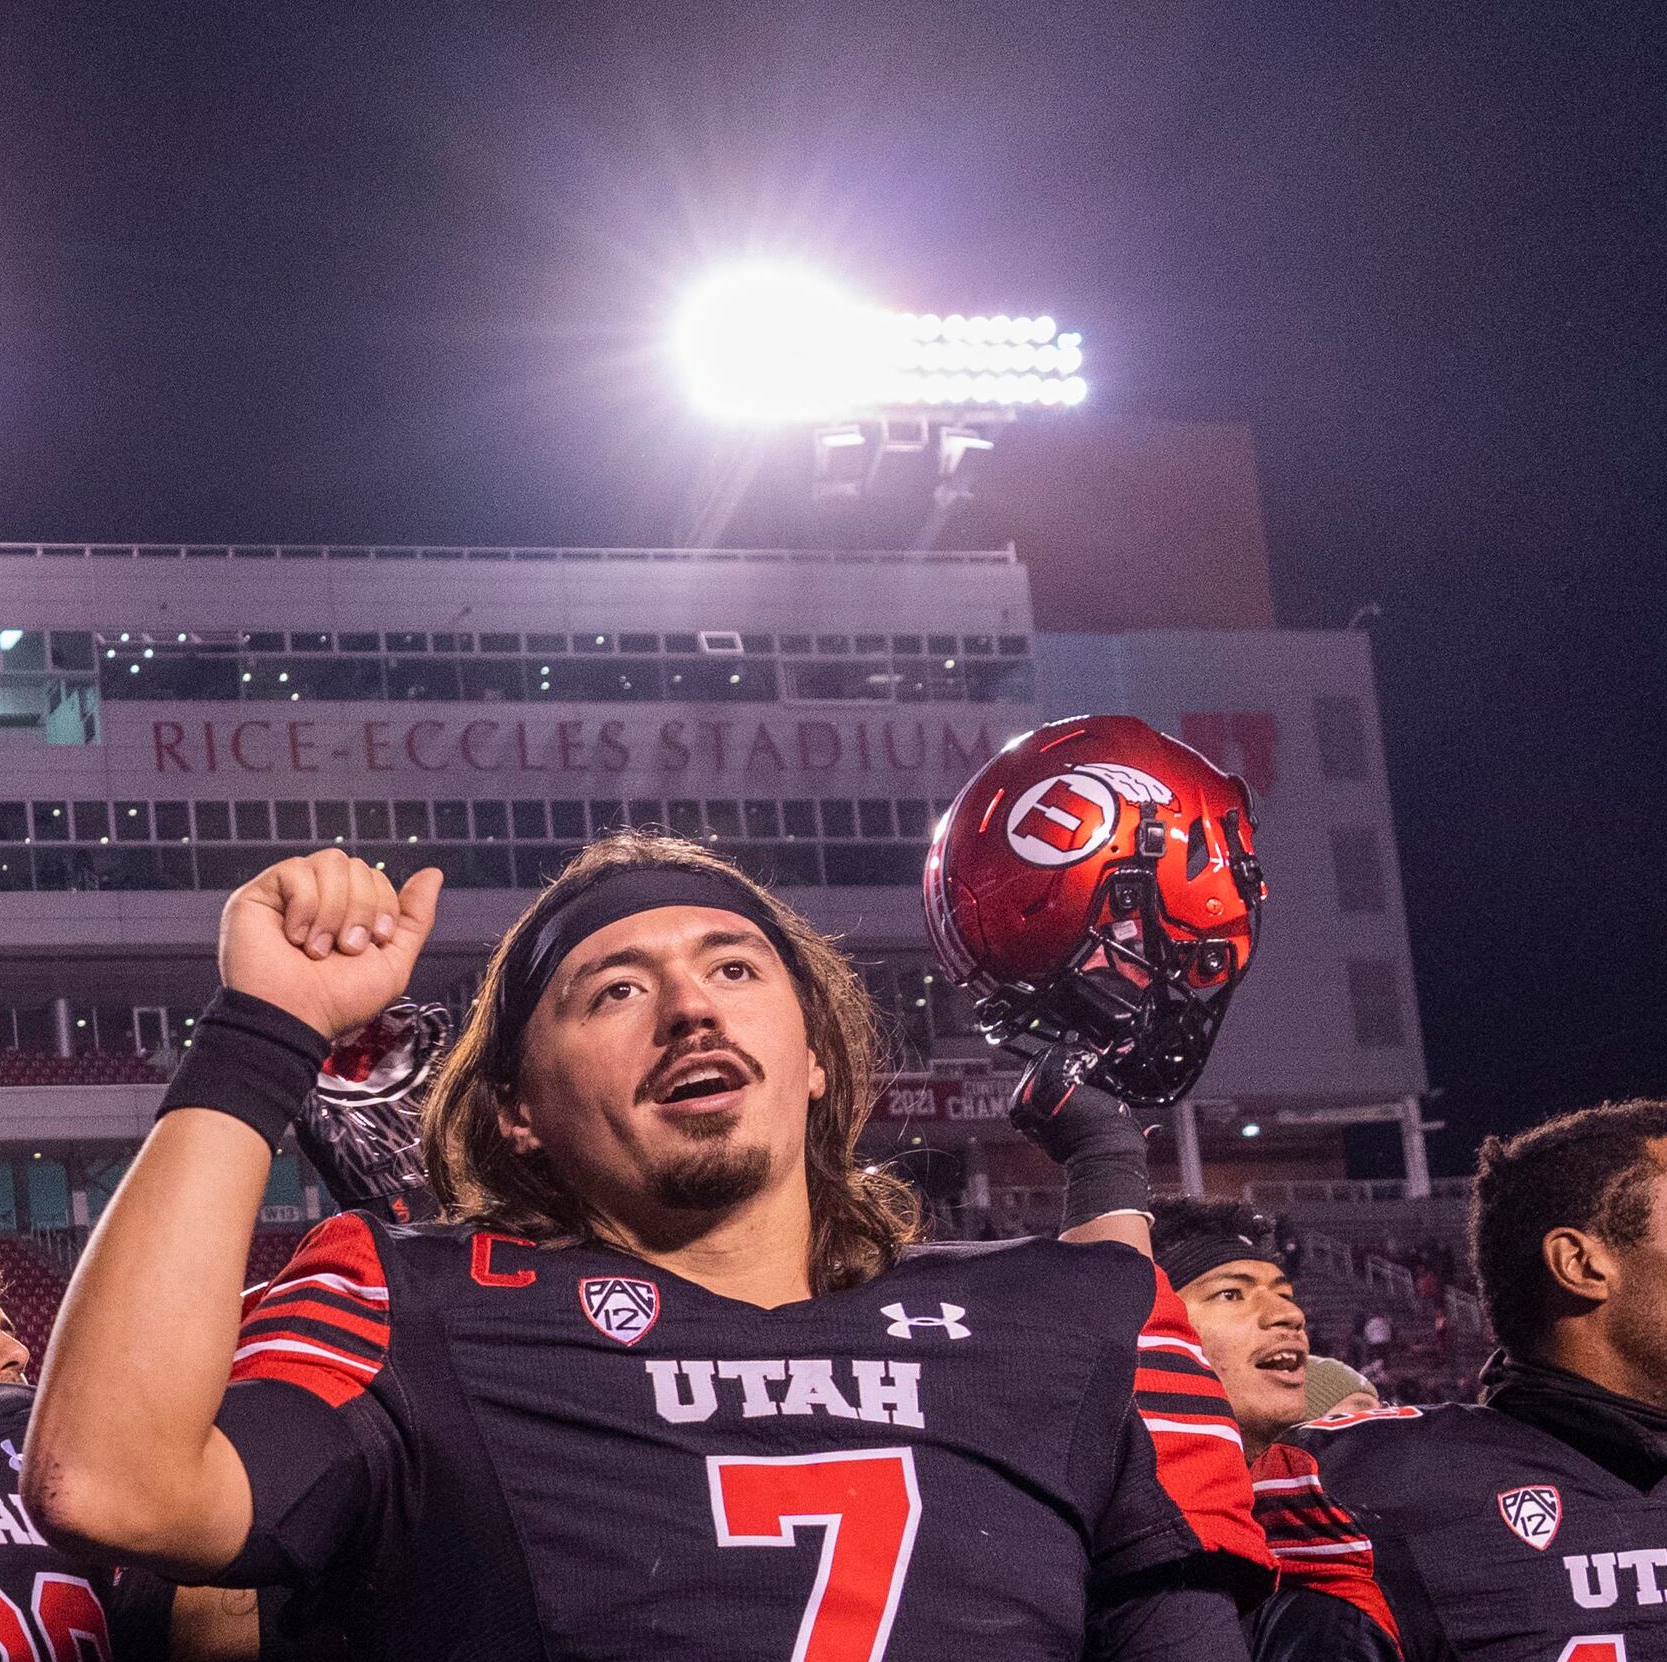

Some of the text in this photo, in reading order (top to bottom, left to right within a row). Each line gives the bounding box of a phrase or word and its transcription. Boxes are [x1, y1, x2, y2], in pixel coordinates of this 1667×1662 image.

[152, 719, 1001, 773] RICE-ECCLES STADIUM
[1011, 778, 1105, 853] U
[470, 1232, 537, 1288] C
[583, 1279, 655, 1317] PAC
[602, 1307, 642, 1332] 12
[645, 1359, 926, 1429] UTAH
[1503, 1489, 1558, 1525] PAC
[1520, 1514, 1551, 1537] 12
[1563, 1548, 1667, 1609] UT
